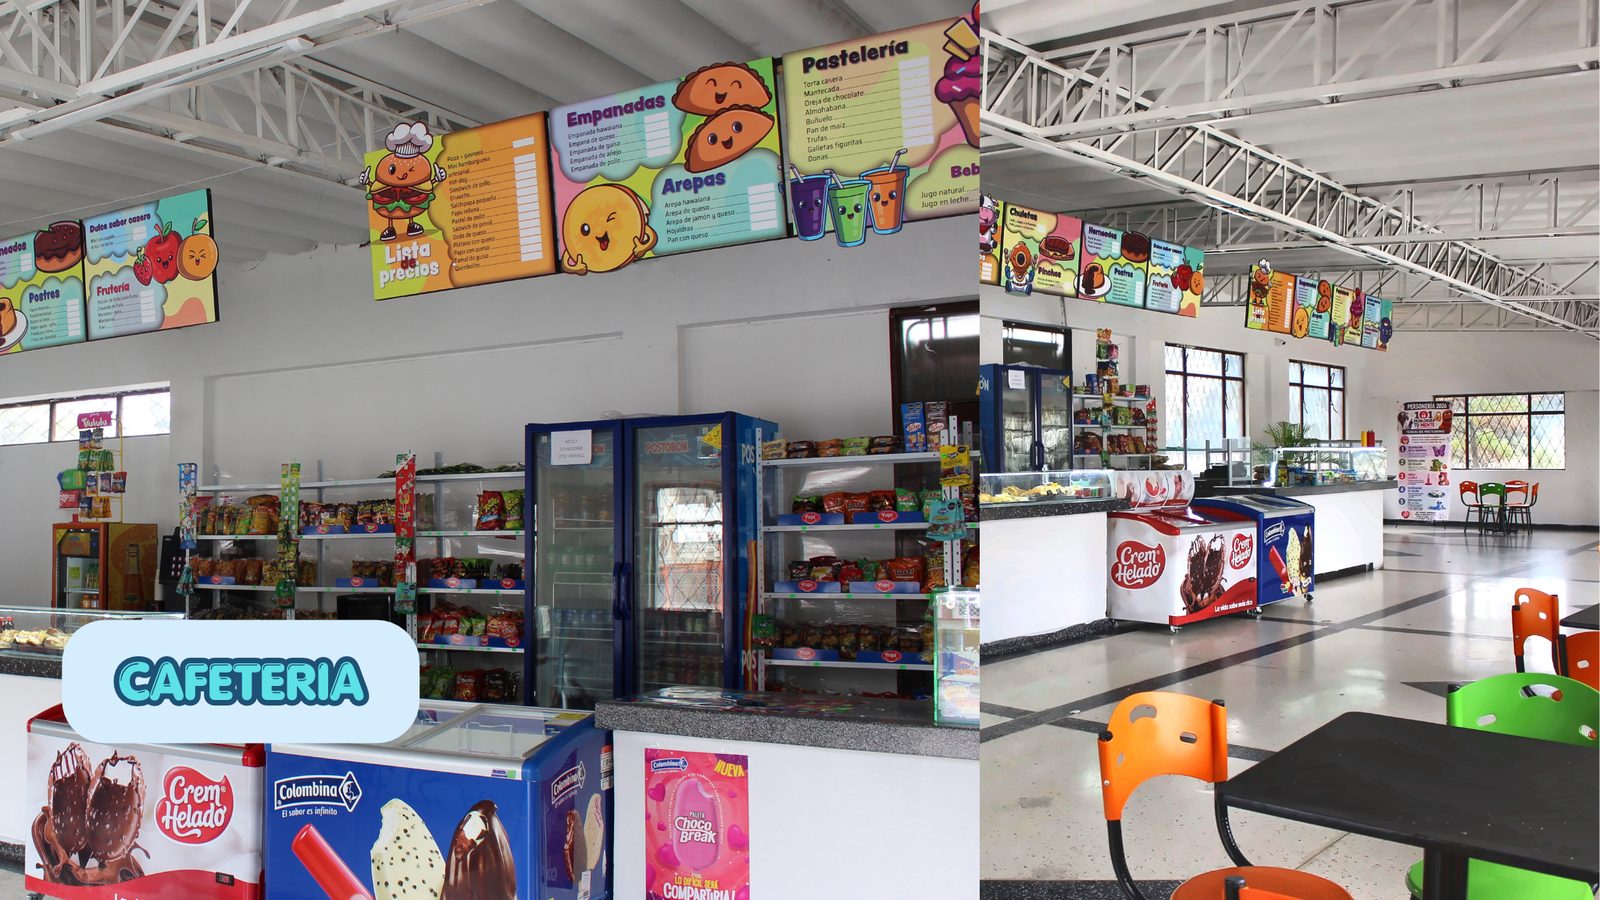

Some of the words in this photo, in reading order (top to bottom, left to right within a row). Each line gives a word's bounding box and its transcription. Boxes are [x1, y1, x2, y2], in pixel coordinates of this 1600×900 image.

[802, 40, 908, 74] Pastelería
[822, 76, 842, 84] casera
[804, 86, 840, 97] Mantecada
[832, 90, 864, 101] chocolate
[567, 95, 665, 127] Empanadas
[805, 104, 846, 115] Almohabana
[806, 116, 832, 125] Buñuelo
[568, 129, 595, 140] Empanada
[597, 123, 622, 134] hawaiana
[599, 133, 615, 142] queso
[570, 146, 597, 156] Empanada
[808, 143, 833, 153] Galletas
[570, 154, 598, 165] Empanada
[571, 162, 598, 173] Empanada
[608, 158, 620, 167] pollo
[479, 180, 490, 188] pollo
[662, 172, 726, 195] Arepas
[939, 186, 964, 196] natural
[665, 201, 681, 209] Arepa
[683, 196, 710, 207] hawaiana
[950, 196, 969, 204] leche
[692, 205, 709, 213] queso
[717, 210, 735, 218] queso
[1010, 207, 1037, 221] Chuletas
[90, 224, 107, 233] Dulce
[109, 219, 127, 228] sabor
[129, 213, 150, 223] casero
[667, 226, 693, 235] Hojaldras
[385, 241, 431, 264] Lista
[401, 256, 416, 269] de
[379, 260, 439, 289] precios
[97, 282, 129, 296] Frutería
[29, 289, 60, 304] Postres
[1234, 537, 1250, 552] Crem
[1121, 547, 1157, 565] Crem
[1231, 549, 1251, 566] Helado
[1115, 561, 1160, 585] Helado
[713, 759, 745, 777] NUEVA
[170, 775, 221, 806] Crem
[279, 780, 337, 800] Colombina
[289, 808, 305, 816] sabor
[315, 807, 337, 816] infinito
[162, 801, 227, 837] Helado
[675, 816, 712, 831] Choco
[680, 830, 717, 844] Break
[675, 876, 682, 885] LO
